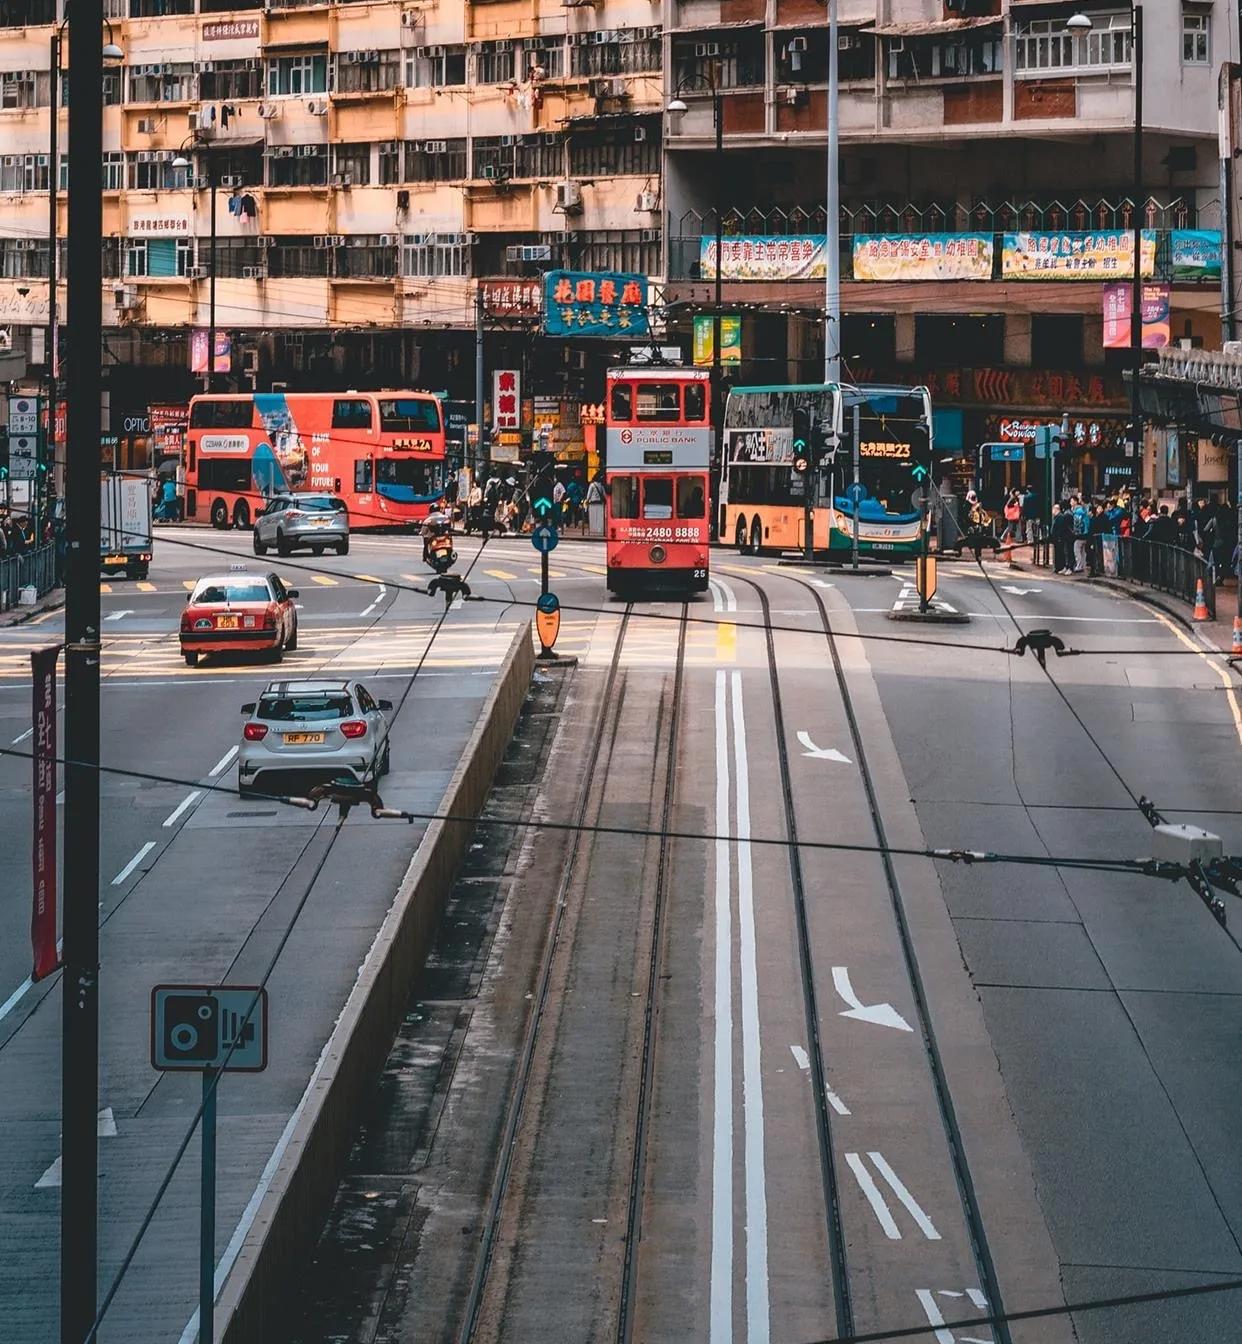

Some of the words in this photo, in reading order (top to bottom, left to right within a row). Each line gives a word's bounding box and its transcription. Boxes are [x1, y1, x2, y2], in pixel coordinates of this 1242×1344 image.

[312, 433, 330, 443] BANK
[419, 439, 431, 450] 2A
[312, 447, 321, 456] OF
[311, 463, 329, 472] YOUR
[311, 477, 334, 487] FUTURE
[646, 527, 672, 537] 2480
[675, 527, 700, 537] 8888
[694, 570, 706, 578] 25
[304, 734, 320, 742] 770
